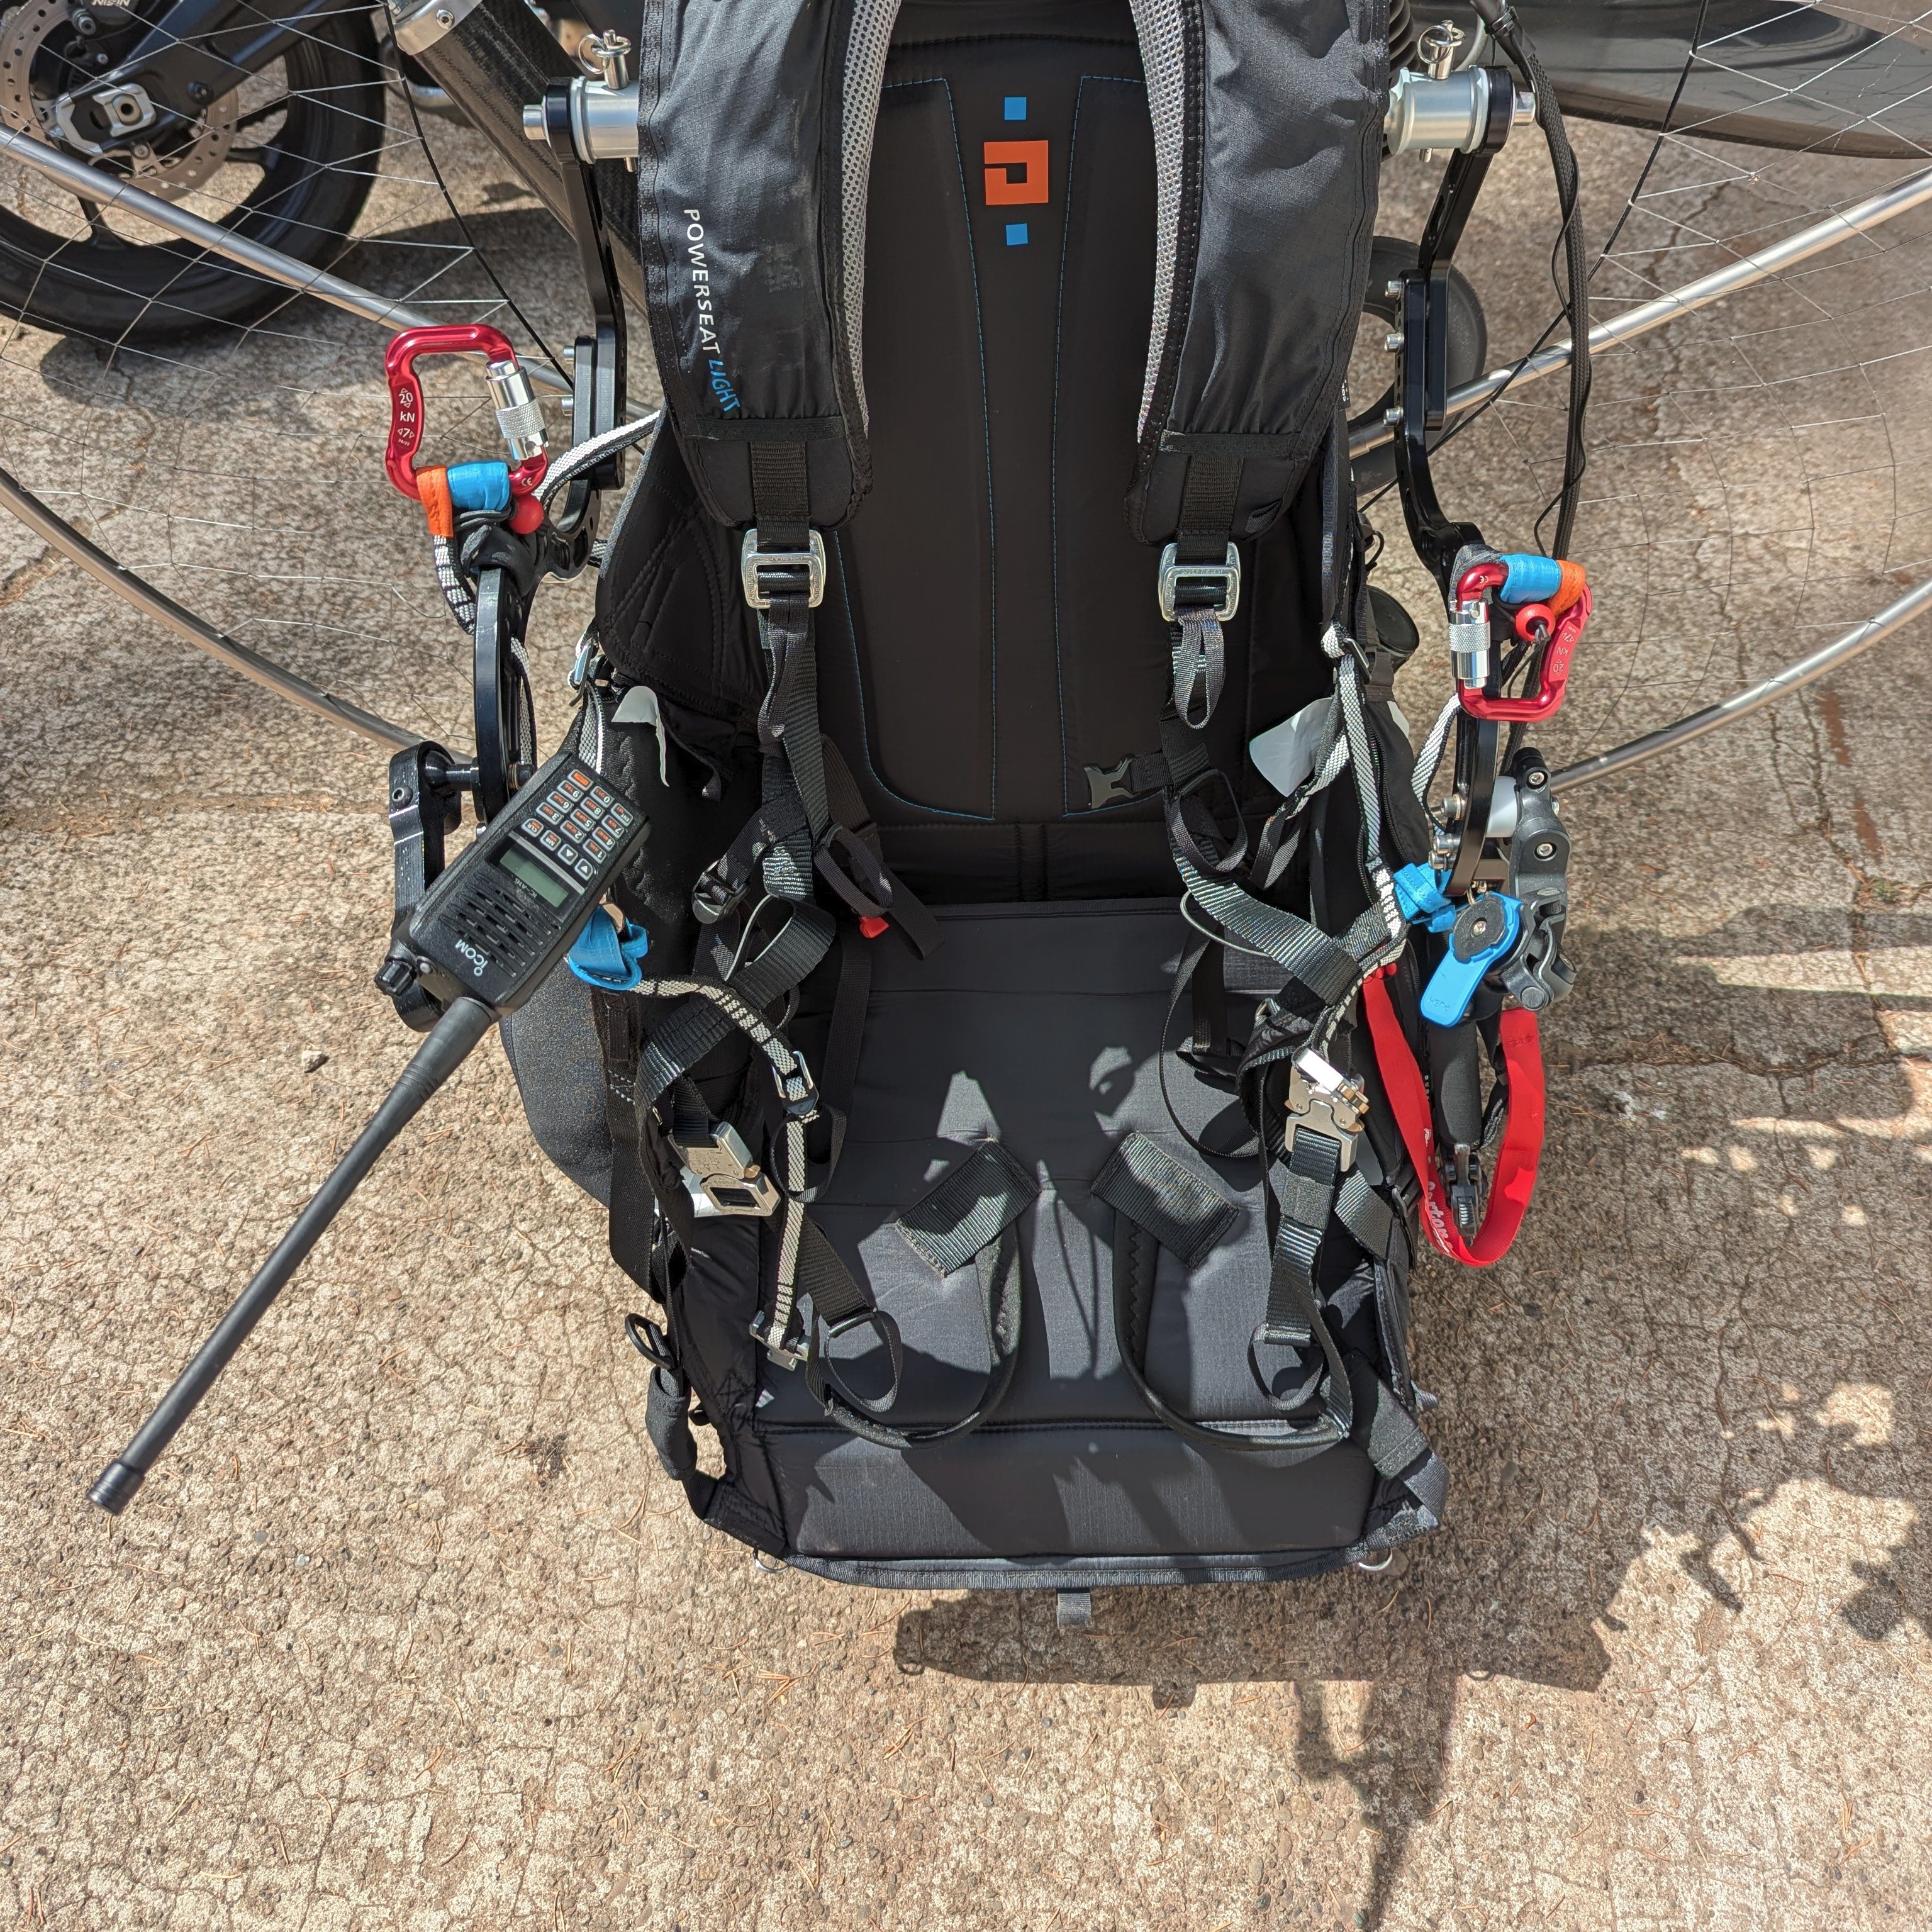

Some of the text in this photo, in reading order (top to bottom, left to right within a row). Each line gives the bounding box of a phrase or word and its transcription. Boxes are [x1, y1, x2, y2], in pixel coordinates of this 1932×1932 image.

[683, 208, 741, 413] POWERSEAT LIGHT
[398, 391, 413, 405] 20
[399, 410, 415, 423] kN
[526, 822, 538, 833] CLR
[513, 877, 537, 898] IC-A16
[1427, 996, 1450, 1012] PUSH
